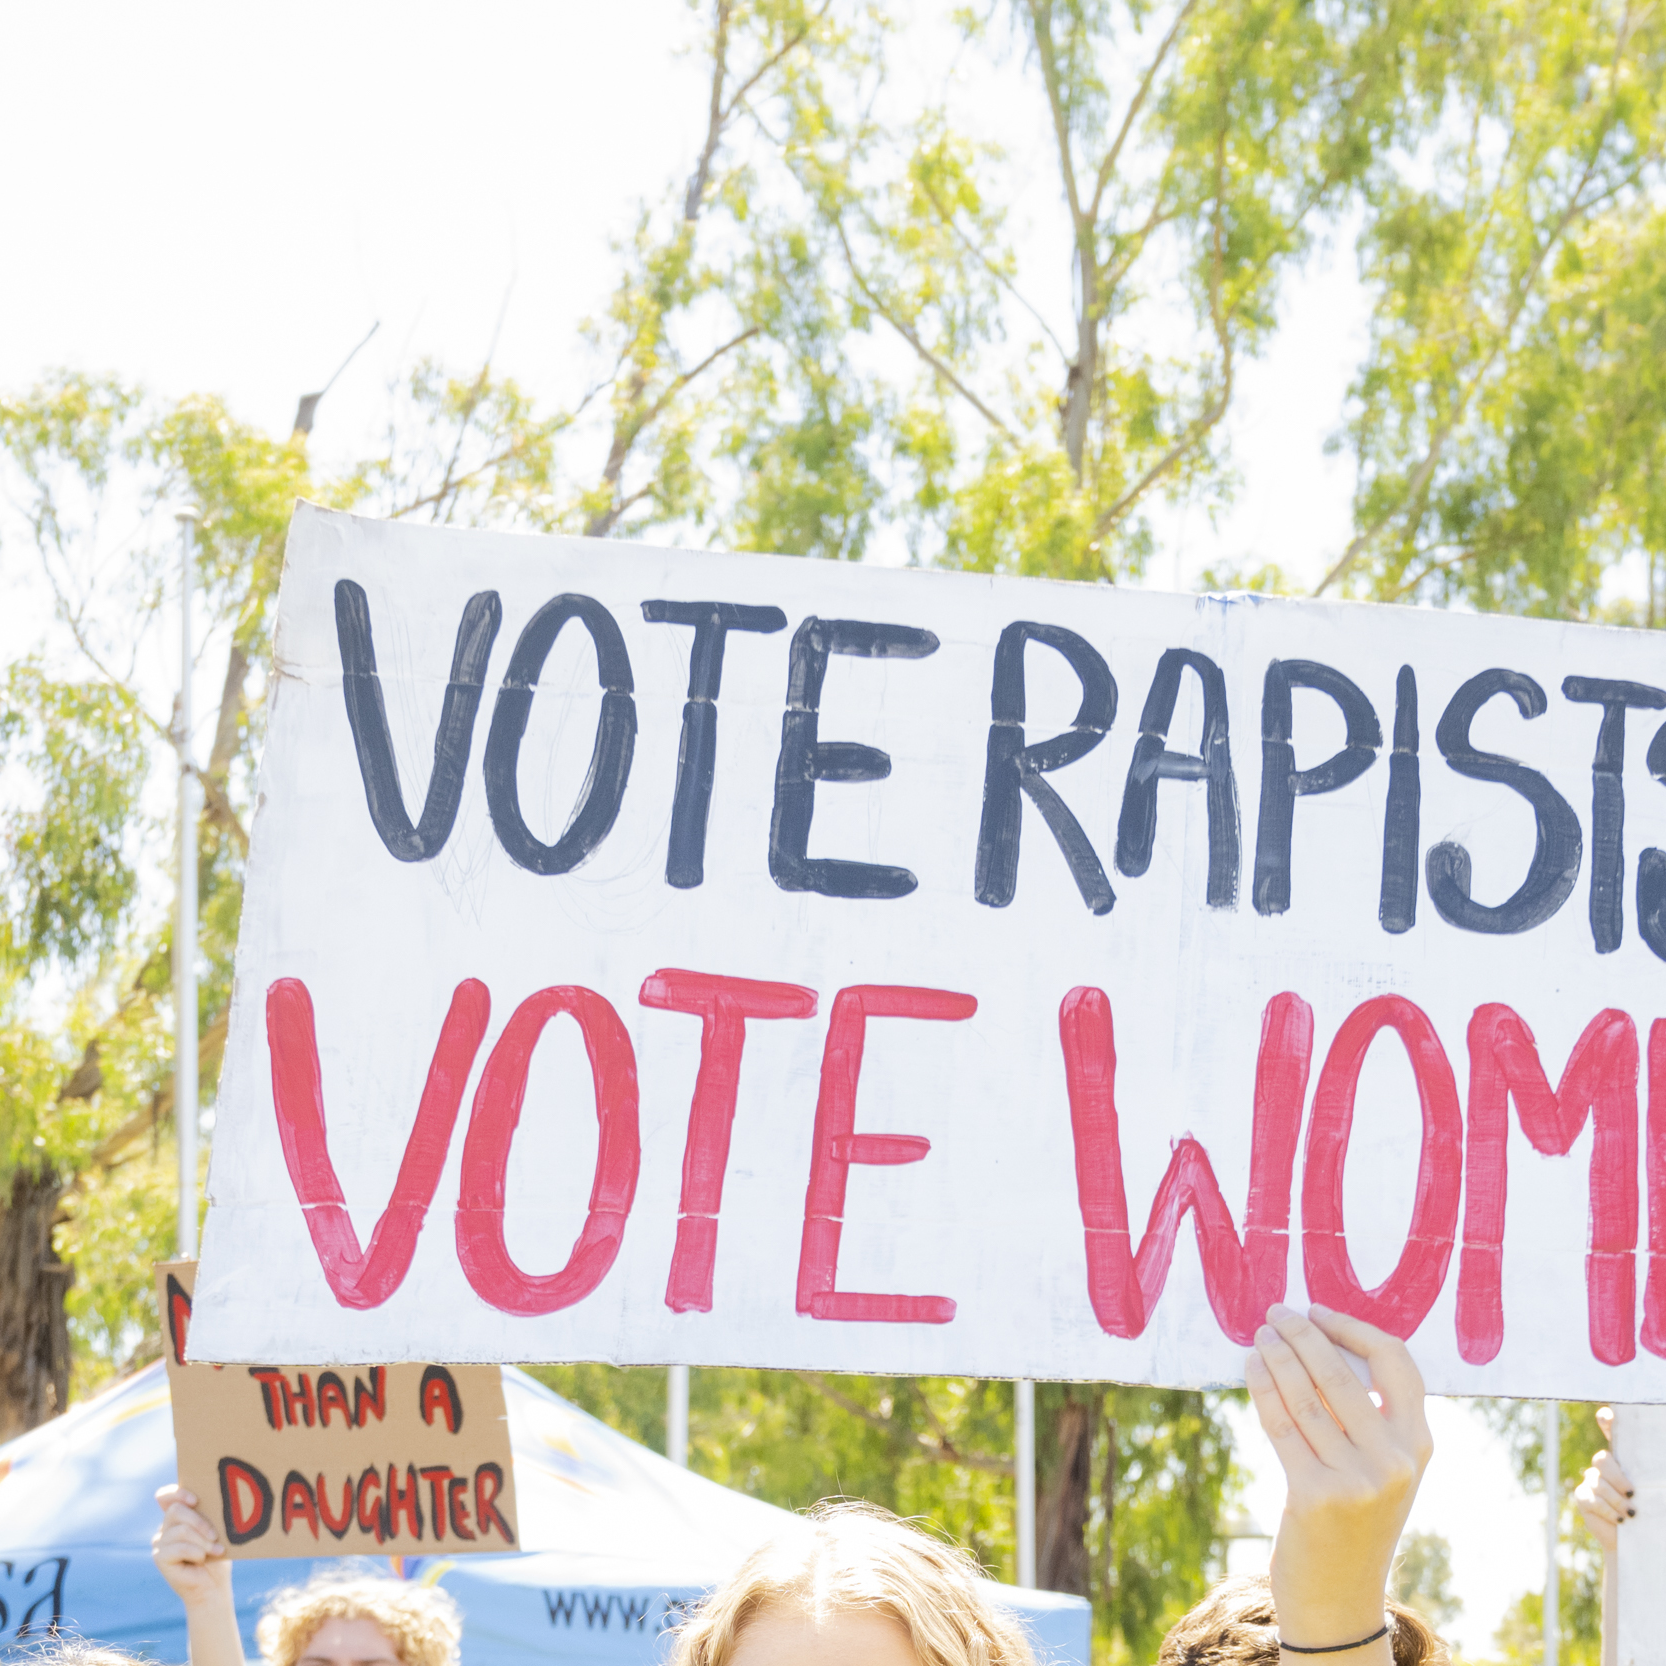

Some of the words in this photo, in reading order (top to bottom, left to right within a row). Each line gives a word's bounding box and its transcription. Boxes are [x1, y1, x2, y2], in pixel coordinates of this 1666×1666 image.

[334, 579, 940, 899] VOTE
[266, 967, 979, 1325] VOTE
[218, 1456, 515, 1545] DAUGHTER
[249, 1366, 387, 1431] THAN
[420, 1364, 463, 1434] A
